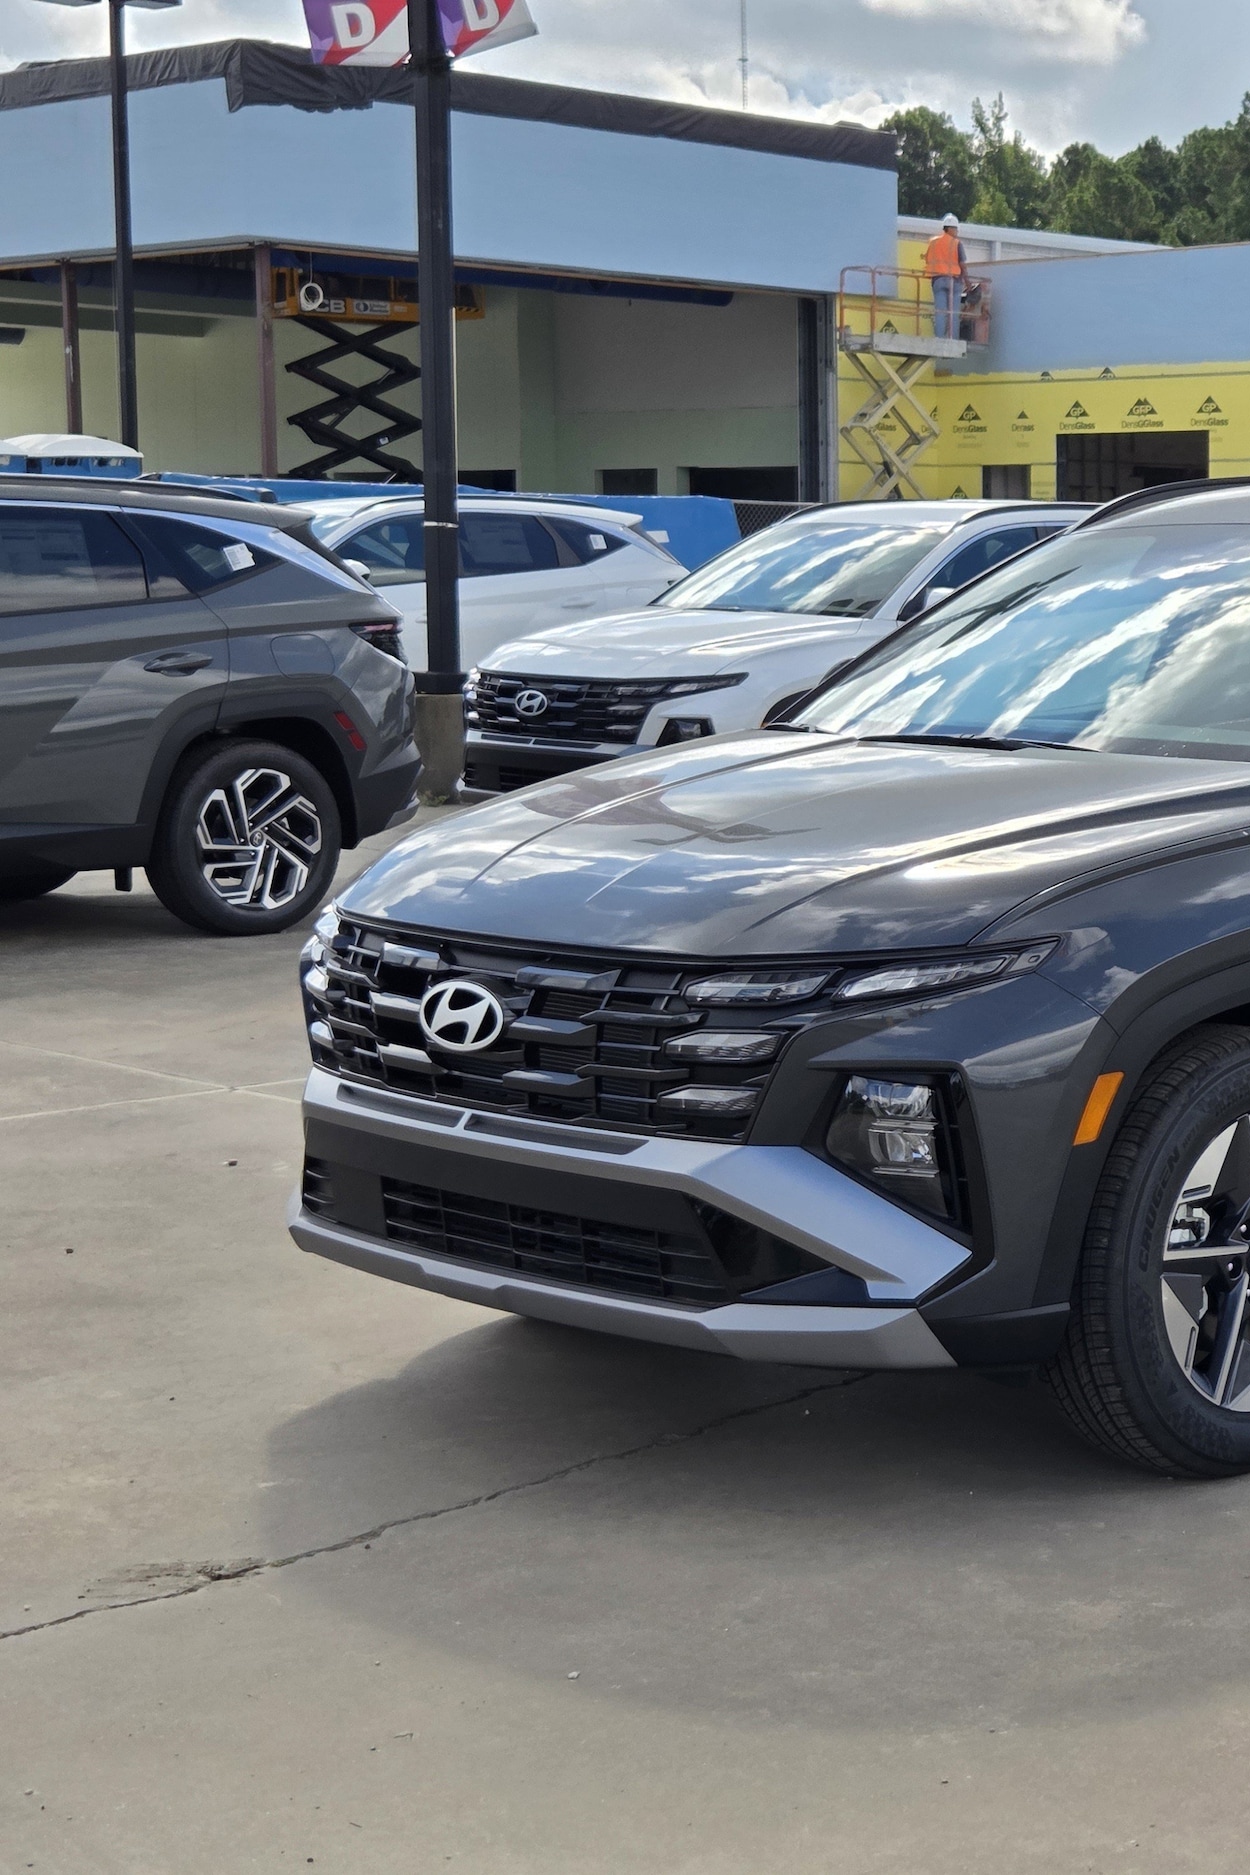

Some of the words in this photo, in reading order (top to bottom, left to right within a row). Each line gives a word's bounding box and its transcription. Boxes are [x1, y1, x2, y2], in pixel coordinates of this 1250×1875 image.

[331, 2, 376, 49] D
[303, 299, 346, 313] CB
[1060, 422, 1096, 430] DensGlass
[1191, 418, 1229, 426] DensGlass
[1139, 1146, 1181, 1273] CRUGEN
